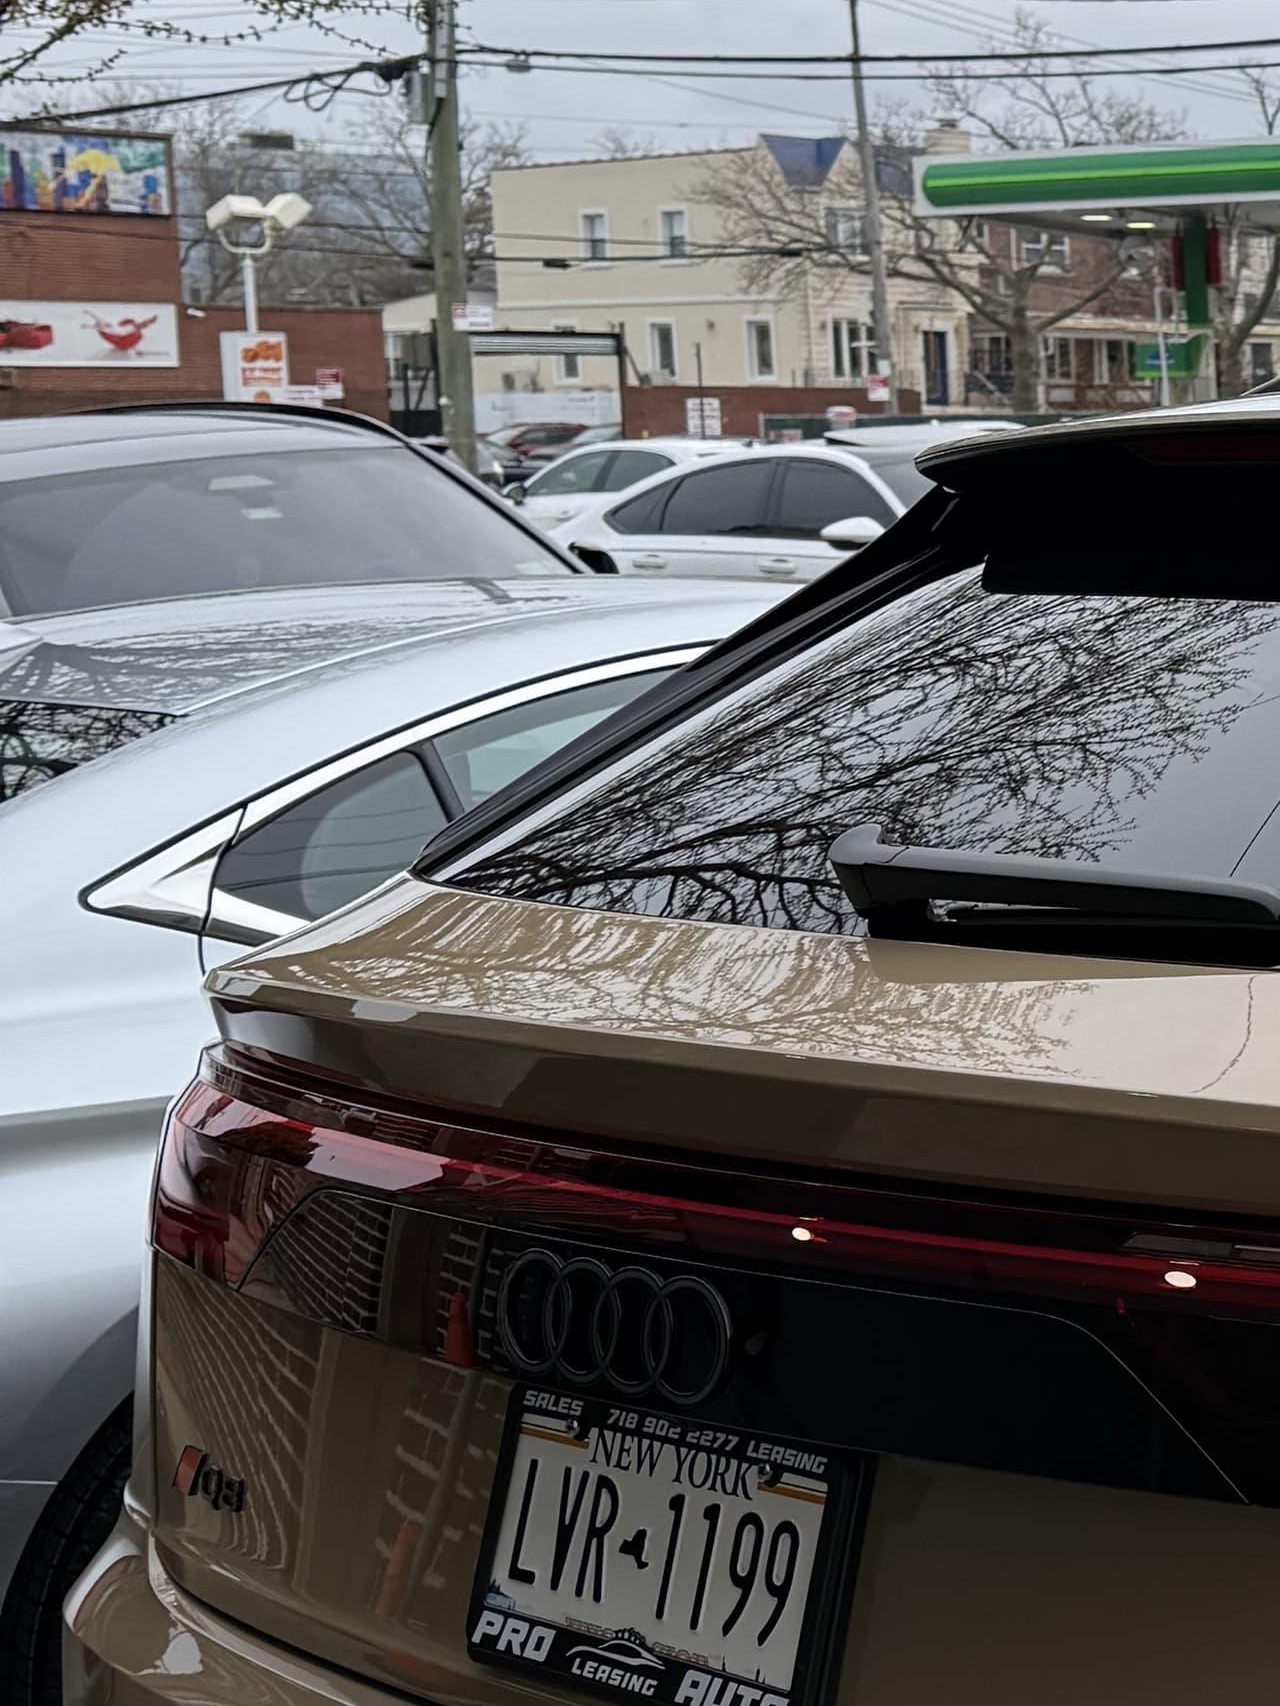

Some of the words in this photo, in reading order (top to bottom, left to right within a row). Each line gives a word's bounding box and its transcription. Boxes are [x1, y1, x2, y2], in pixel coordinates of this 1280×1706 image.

[523, 1390, 584, 1416] SALES
[607, 1409, 639, 1429] 718
[642, 1417, 682, 1440] 902
[686, 1429, 739, 1452] 2277
[747, 1440, 829, 1474] LEASING
[588, 1428, 665, 1477] NEW
[671, 1446, 755, 1501] YORK
[508, 1459, 619, 1603] LVR
[655, 1493, 800, 1647] 1199
[471, 1611, 557, 1662] PRO
[571, 1657, 658, 1696] LEASING
